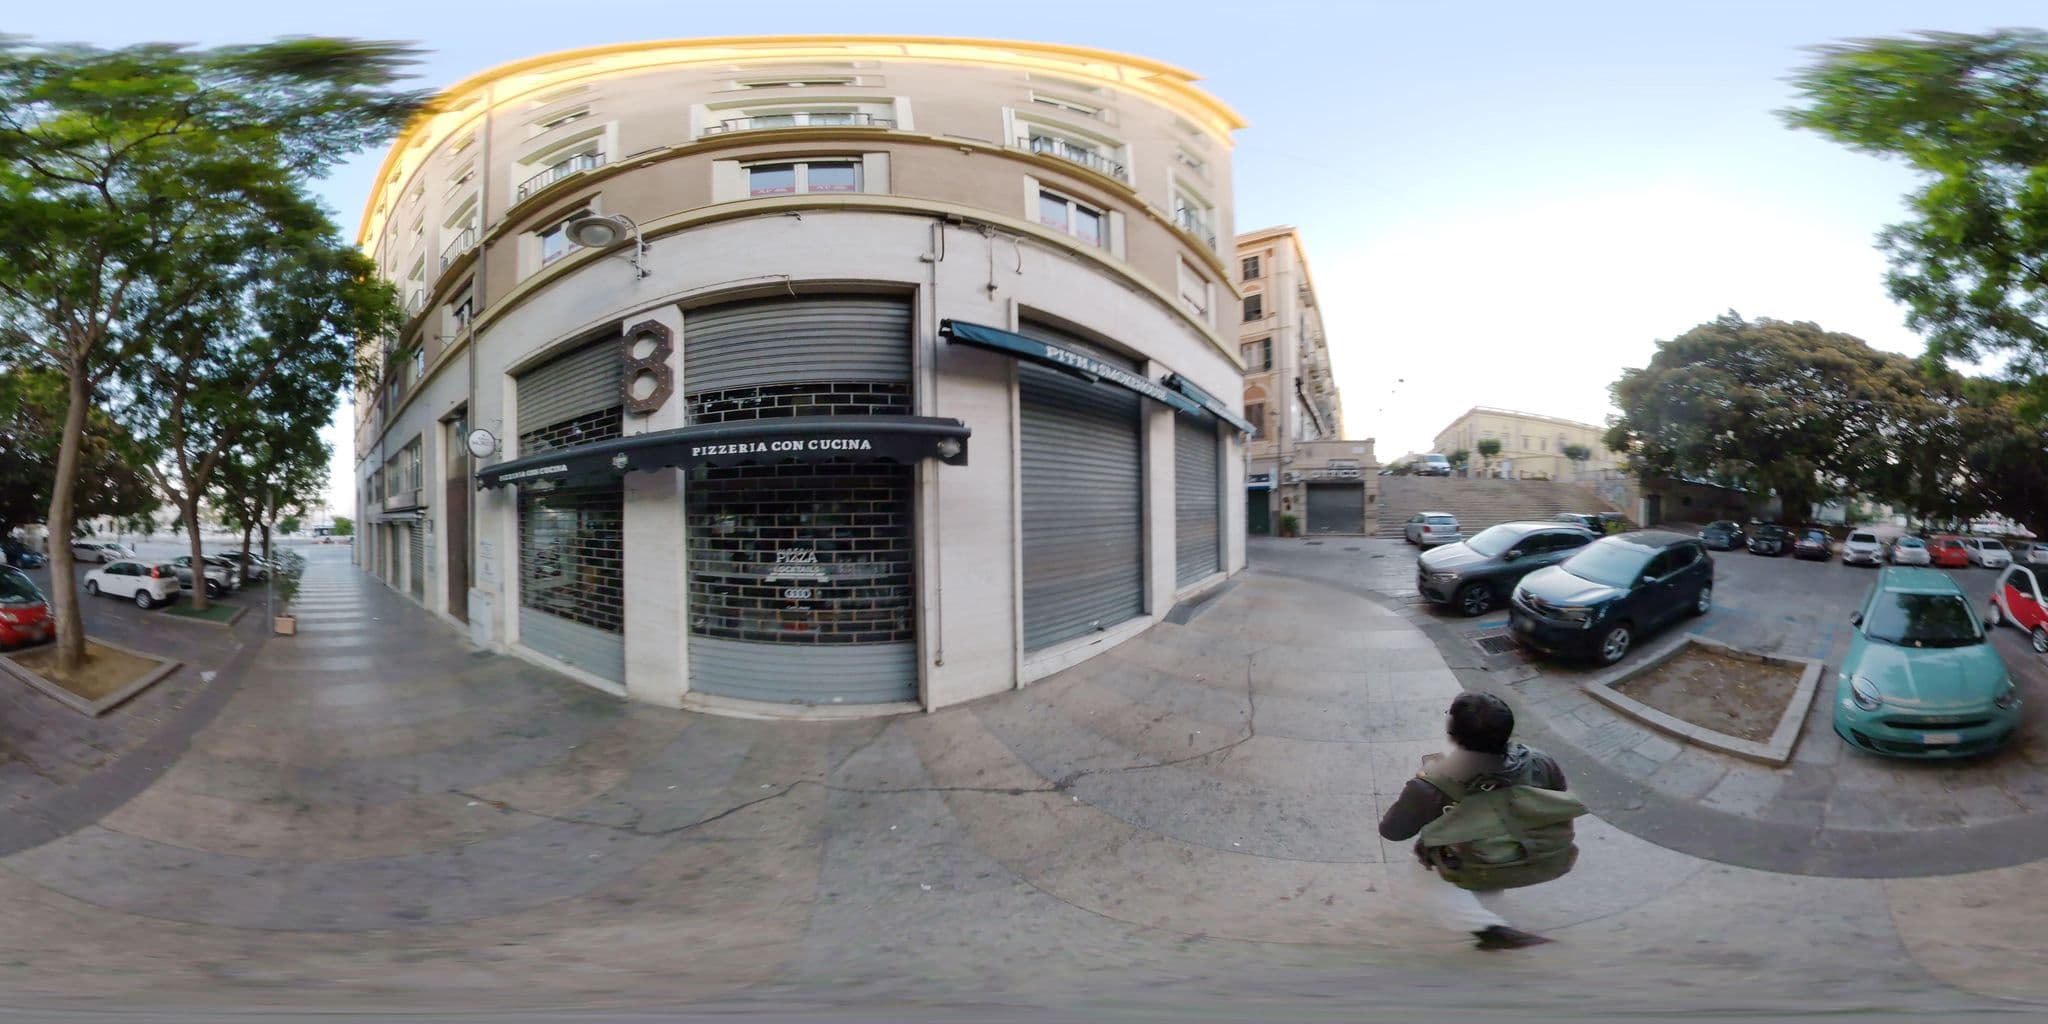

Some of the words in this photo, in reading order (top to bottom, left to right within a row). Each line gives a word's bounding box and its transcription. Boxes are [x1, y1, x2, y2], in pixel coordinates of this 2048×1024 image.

[692, 442, 768, 457] PIZZERIA
[771, 440, 803, 451] CON
[808, 438, 871, 450] CUCINA
[540, 464, 568, 475] CUCINA
[776, 550, 818, 563] PIZZA
